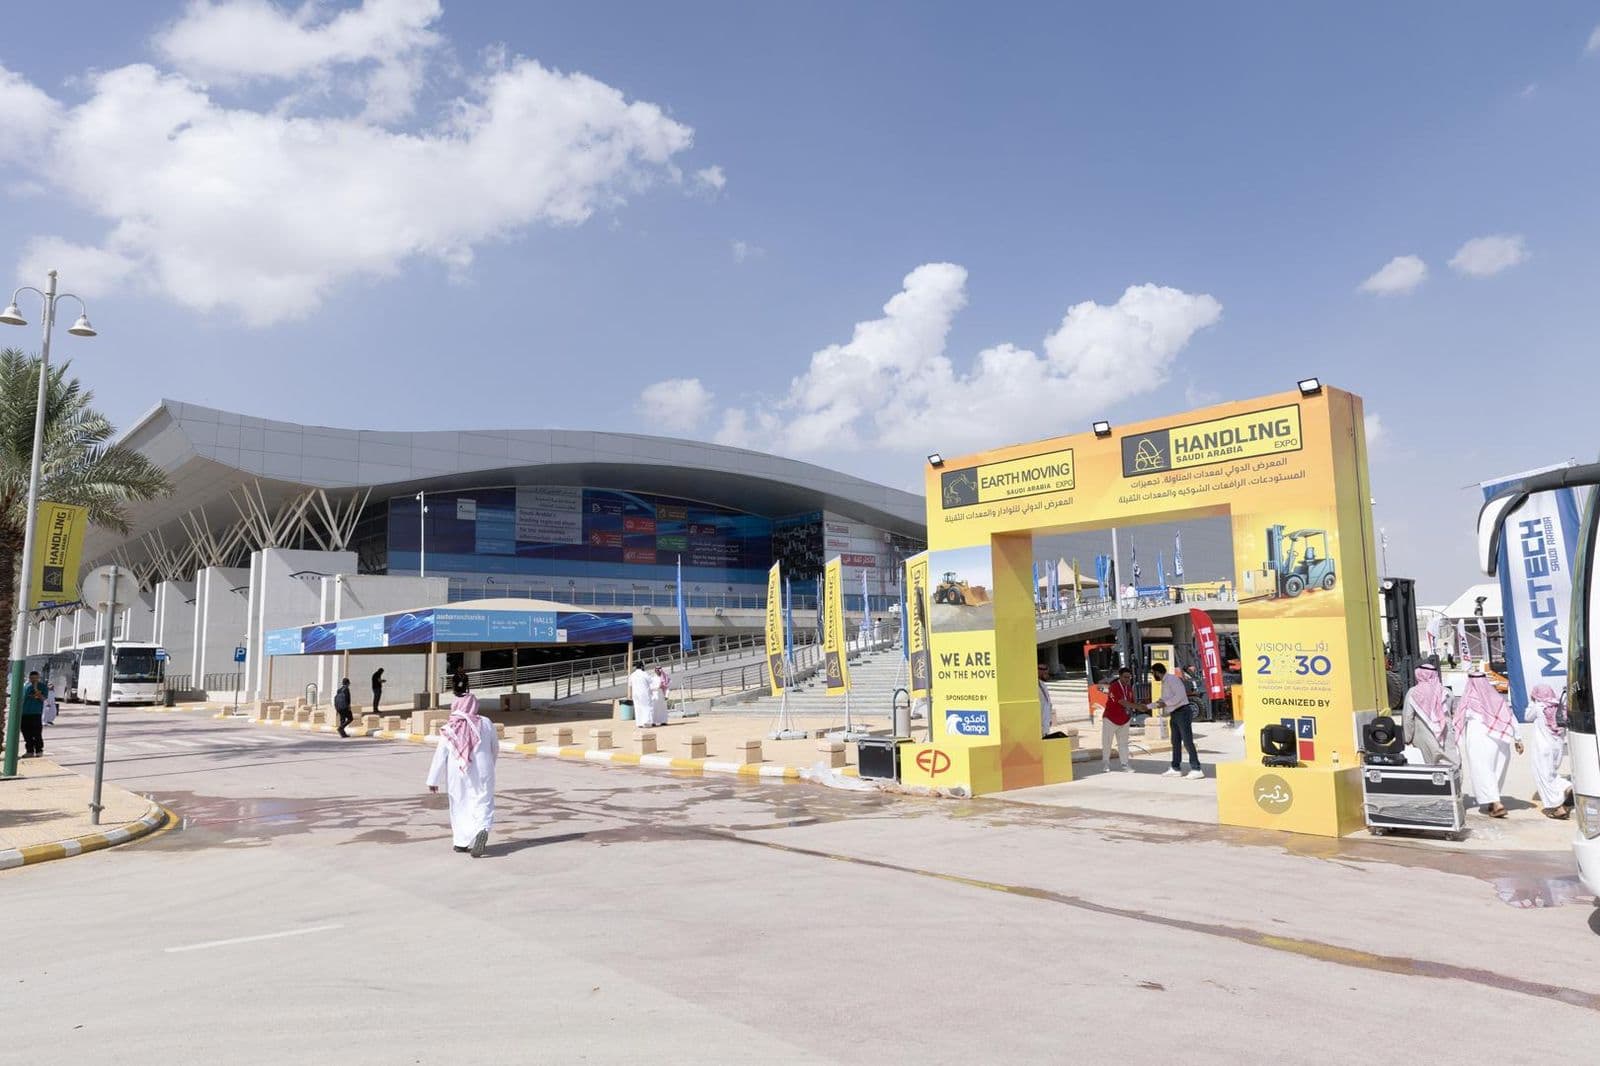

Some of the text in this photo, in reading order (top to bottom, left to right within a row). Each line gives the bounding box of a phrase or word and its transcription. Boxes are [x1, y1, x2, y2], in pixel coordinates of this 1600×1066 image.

[1175, 419, 1291, 454] HANDLING
[1274, 438, 1298, 449] EXPO
[1176, 445, 1243, 463] SAUDI ARABIA
[1225, 463, 1251, 477] الدولي
[1252, 457, 1288, 471] المعرض
[981, 462, 1070, 490] EARTH MOVING
[1006, 483, 1051, 496] SAUDI ARABIA
[1055, 479, 1073, 489] EXPO
[1212, 478, 1247, 492] الرافعات
[1021, 501, 1043, 515] الدولي
[1044, 496, 1073, 511] المعرض
[50, 511, 67, 565] HANDLING
[1543, 517, 1560, 572] SAUDI ARABIA
[1519, 518, 1567, 677] MACTECH
[534, 627, 538, 637] 1
[547, 627, 554, 637] 3
[236, 648, 245, 659] P
[1256, 643, 1292, 652] VISION
[940, 652, 991, 667] WE ARE
[1200, 627, 1221, 693] HELI
[938, 669, 996, 680] ON THE MOVE
[1261, 697, 1330, 708] ORGANIZED BY
